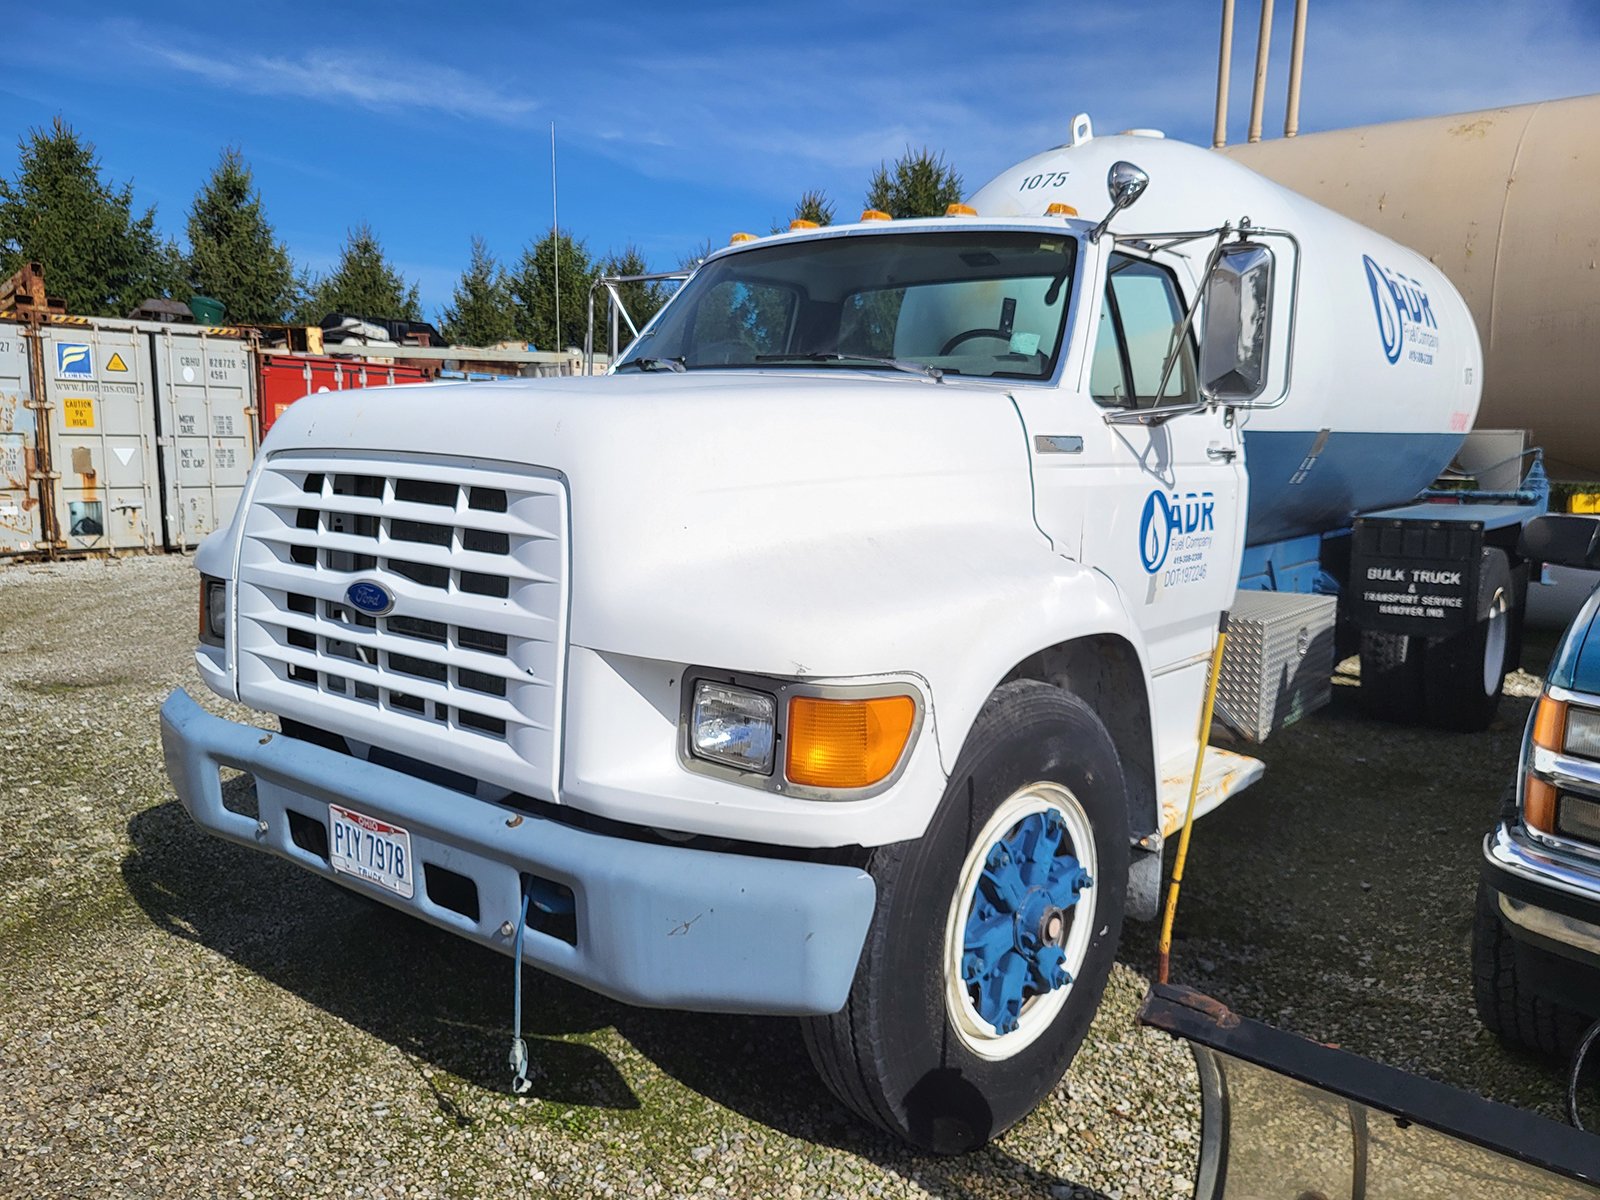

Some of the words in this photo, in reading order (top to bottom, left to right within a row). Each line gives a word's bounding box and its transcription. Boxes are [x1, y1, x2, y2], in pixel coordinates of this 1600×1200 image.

[1019, 171, 1070, 192] 1075
[55, 382, 136, 395] www.florns.com
[65, 400, 92, 409] CAUTION
[1168, 491, 1214, 535] ADR
[1171, 537, 1184, 551] Fuel
[1185, 536, 1212, 550] Company
[1367, 567, 1405, 581] BULK
[1411, 570, 1461, 585] TRUCK
[356, 586, 381, 606] Ford
[1407, 583, 1416, 593] &
[1363, 592, 1419, 604] TRANSPORT
[1421, 595, 1463, 608] SERVICE
[358, 817, 378, 831] OHIO
[335, 822, 361, 862] PIY
[366, 834, 404, 878] 7978
[358, 866, 385, 882] TRUCK
